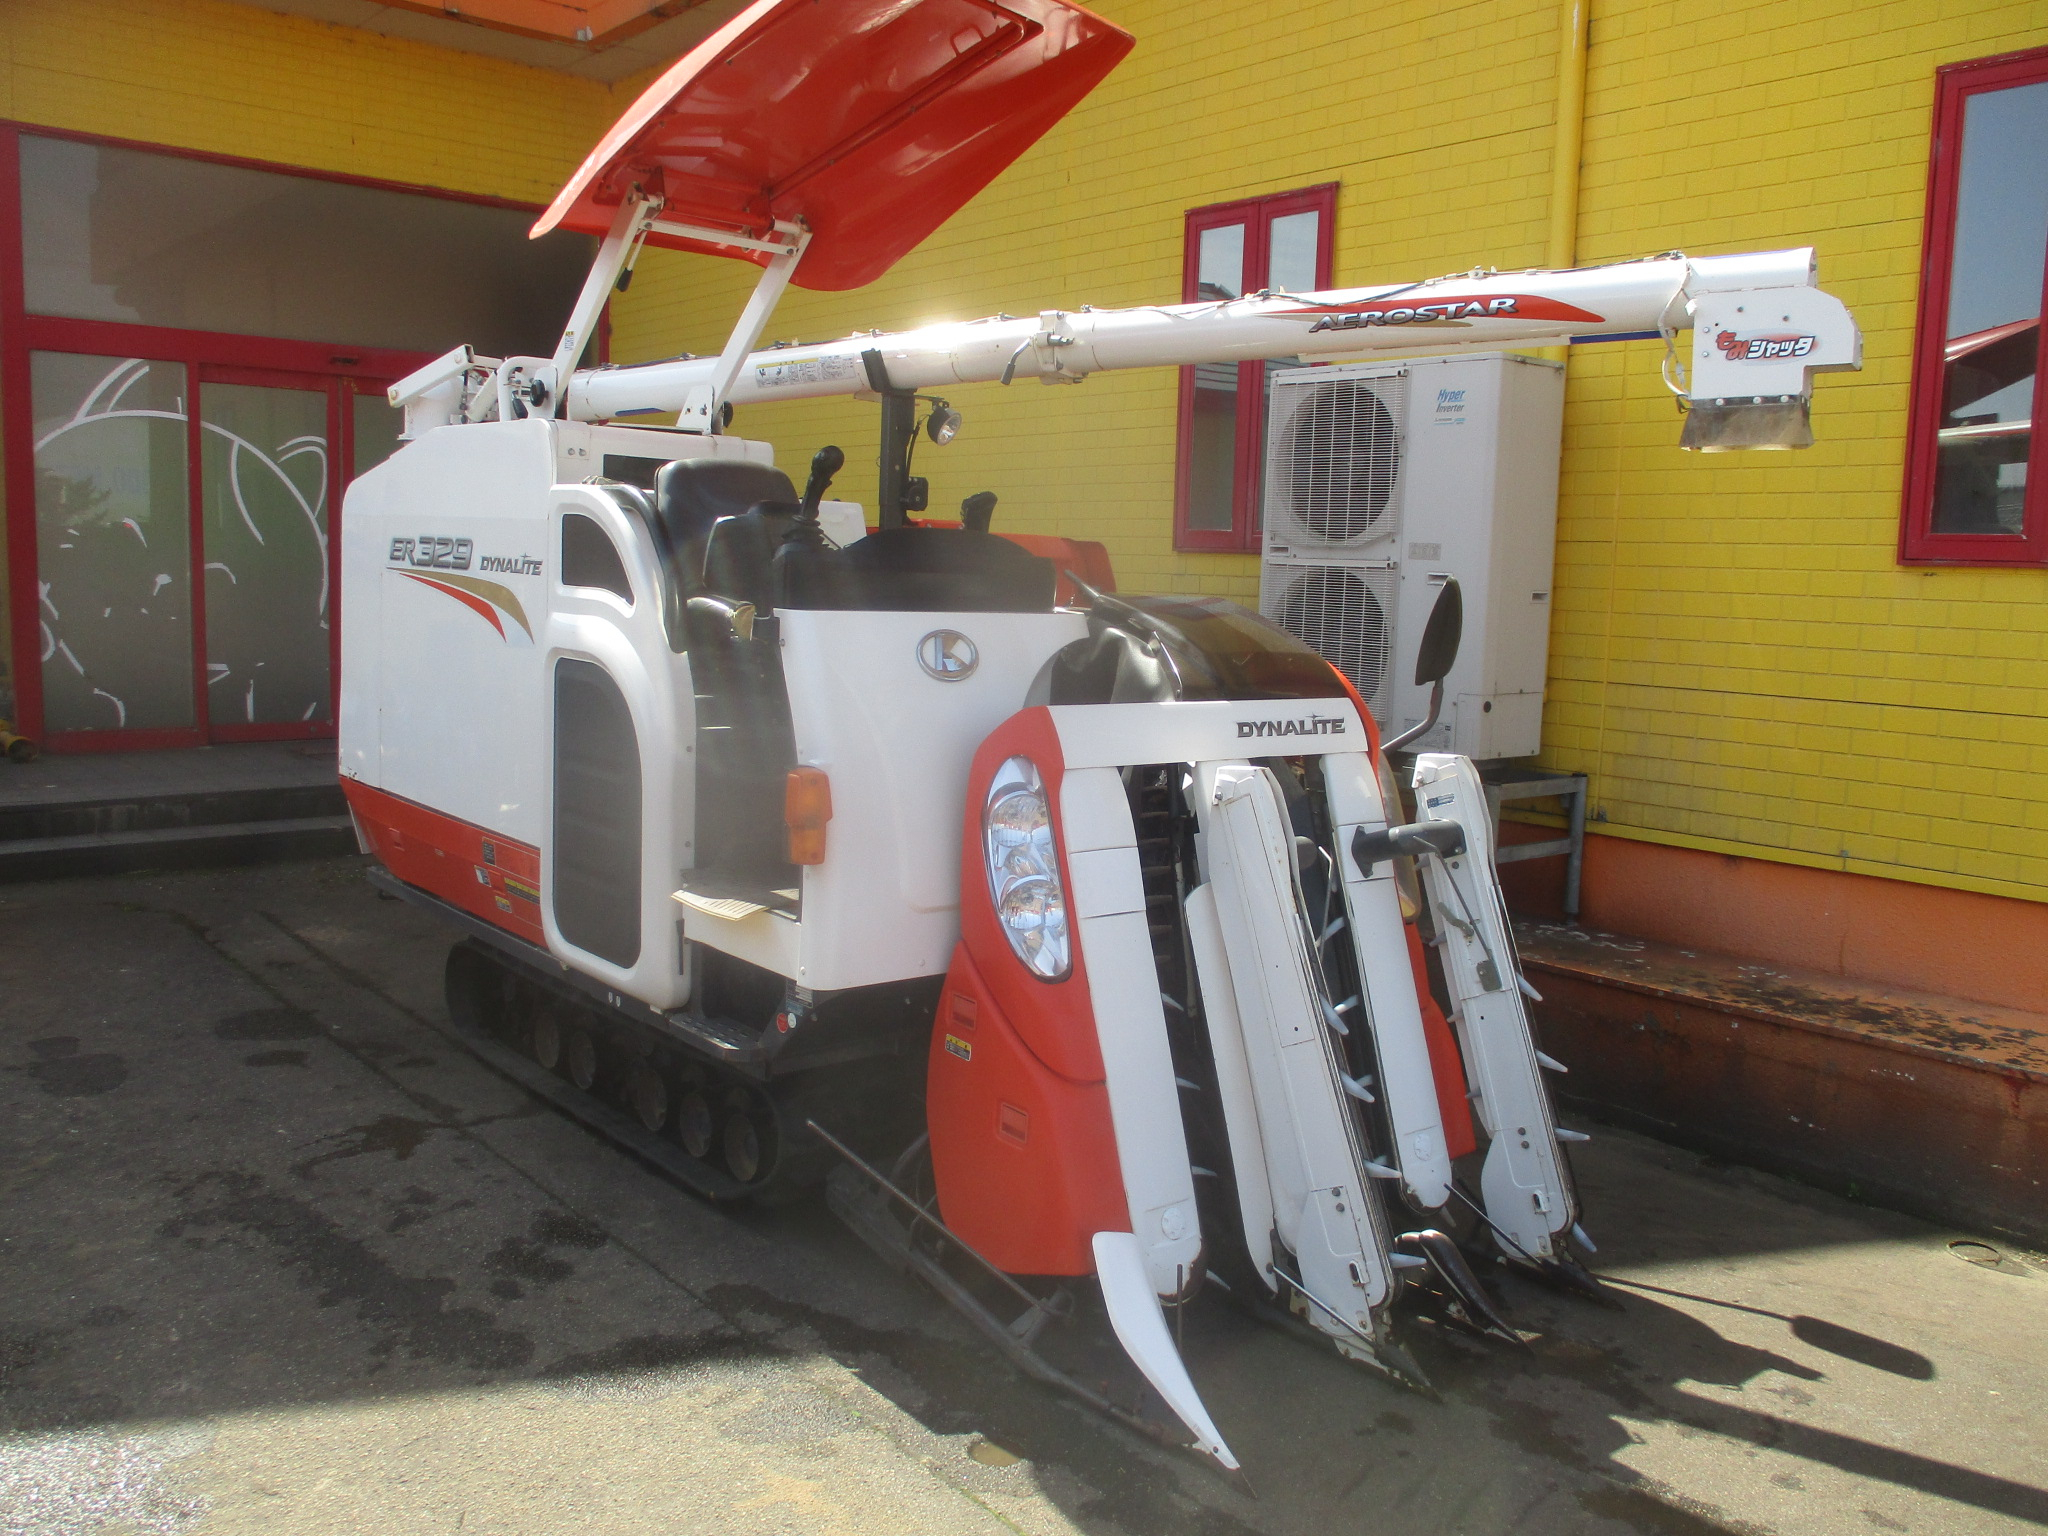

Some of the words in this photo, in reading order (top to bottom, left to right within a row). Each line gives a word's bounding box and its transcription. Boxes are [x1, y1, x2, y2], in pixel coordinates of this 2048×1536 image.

[1309, 298, 1518, 333] AEROSTAR
[1716, 330, 1815, 361] もみシャッタ
[1436, 402, 1465, 413] Inverter
[1437, 389, 1466, 403] Hyper
[389, 535, 473, 571] ER329
[480, 554, 543, 576] DYNALITE
[1236, 714, 1346, 739] DYNALITE
